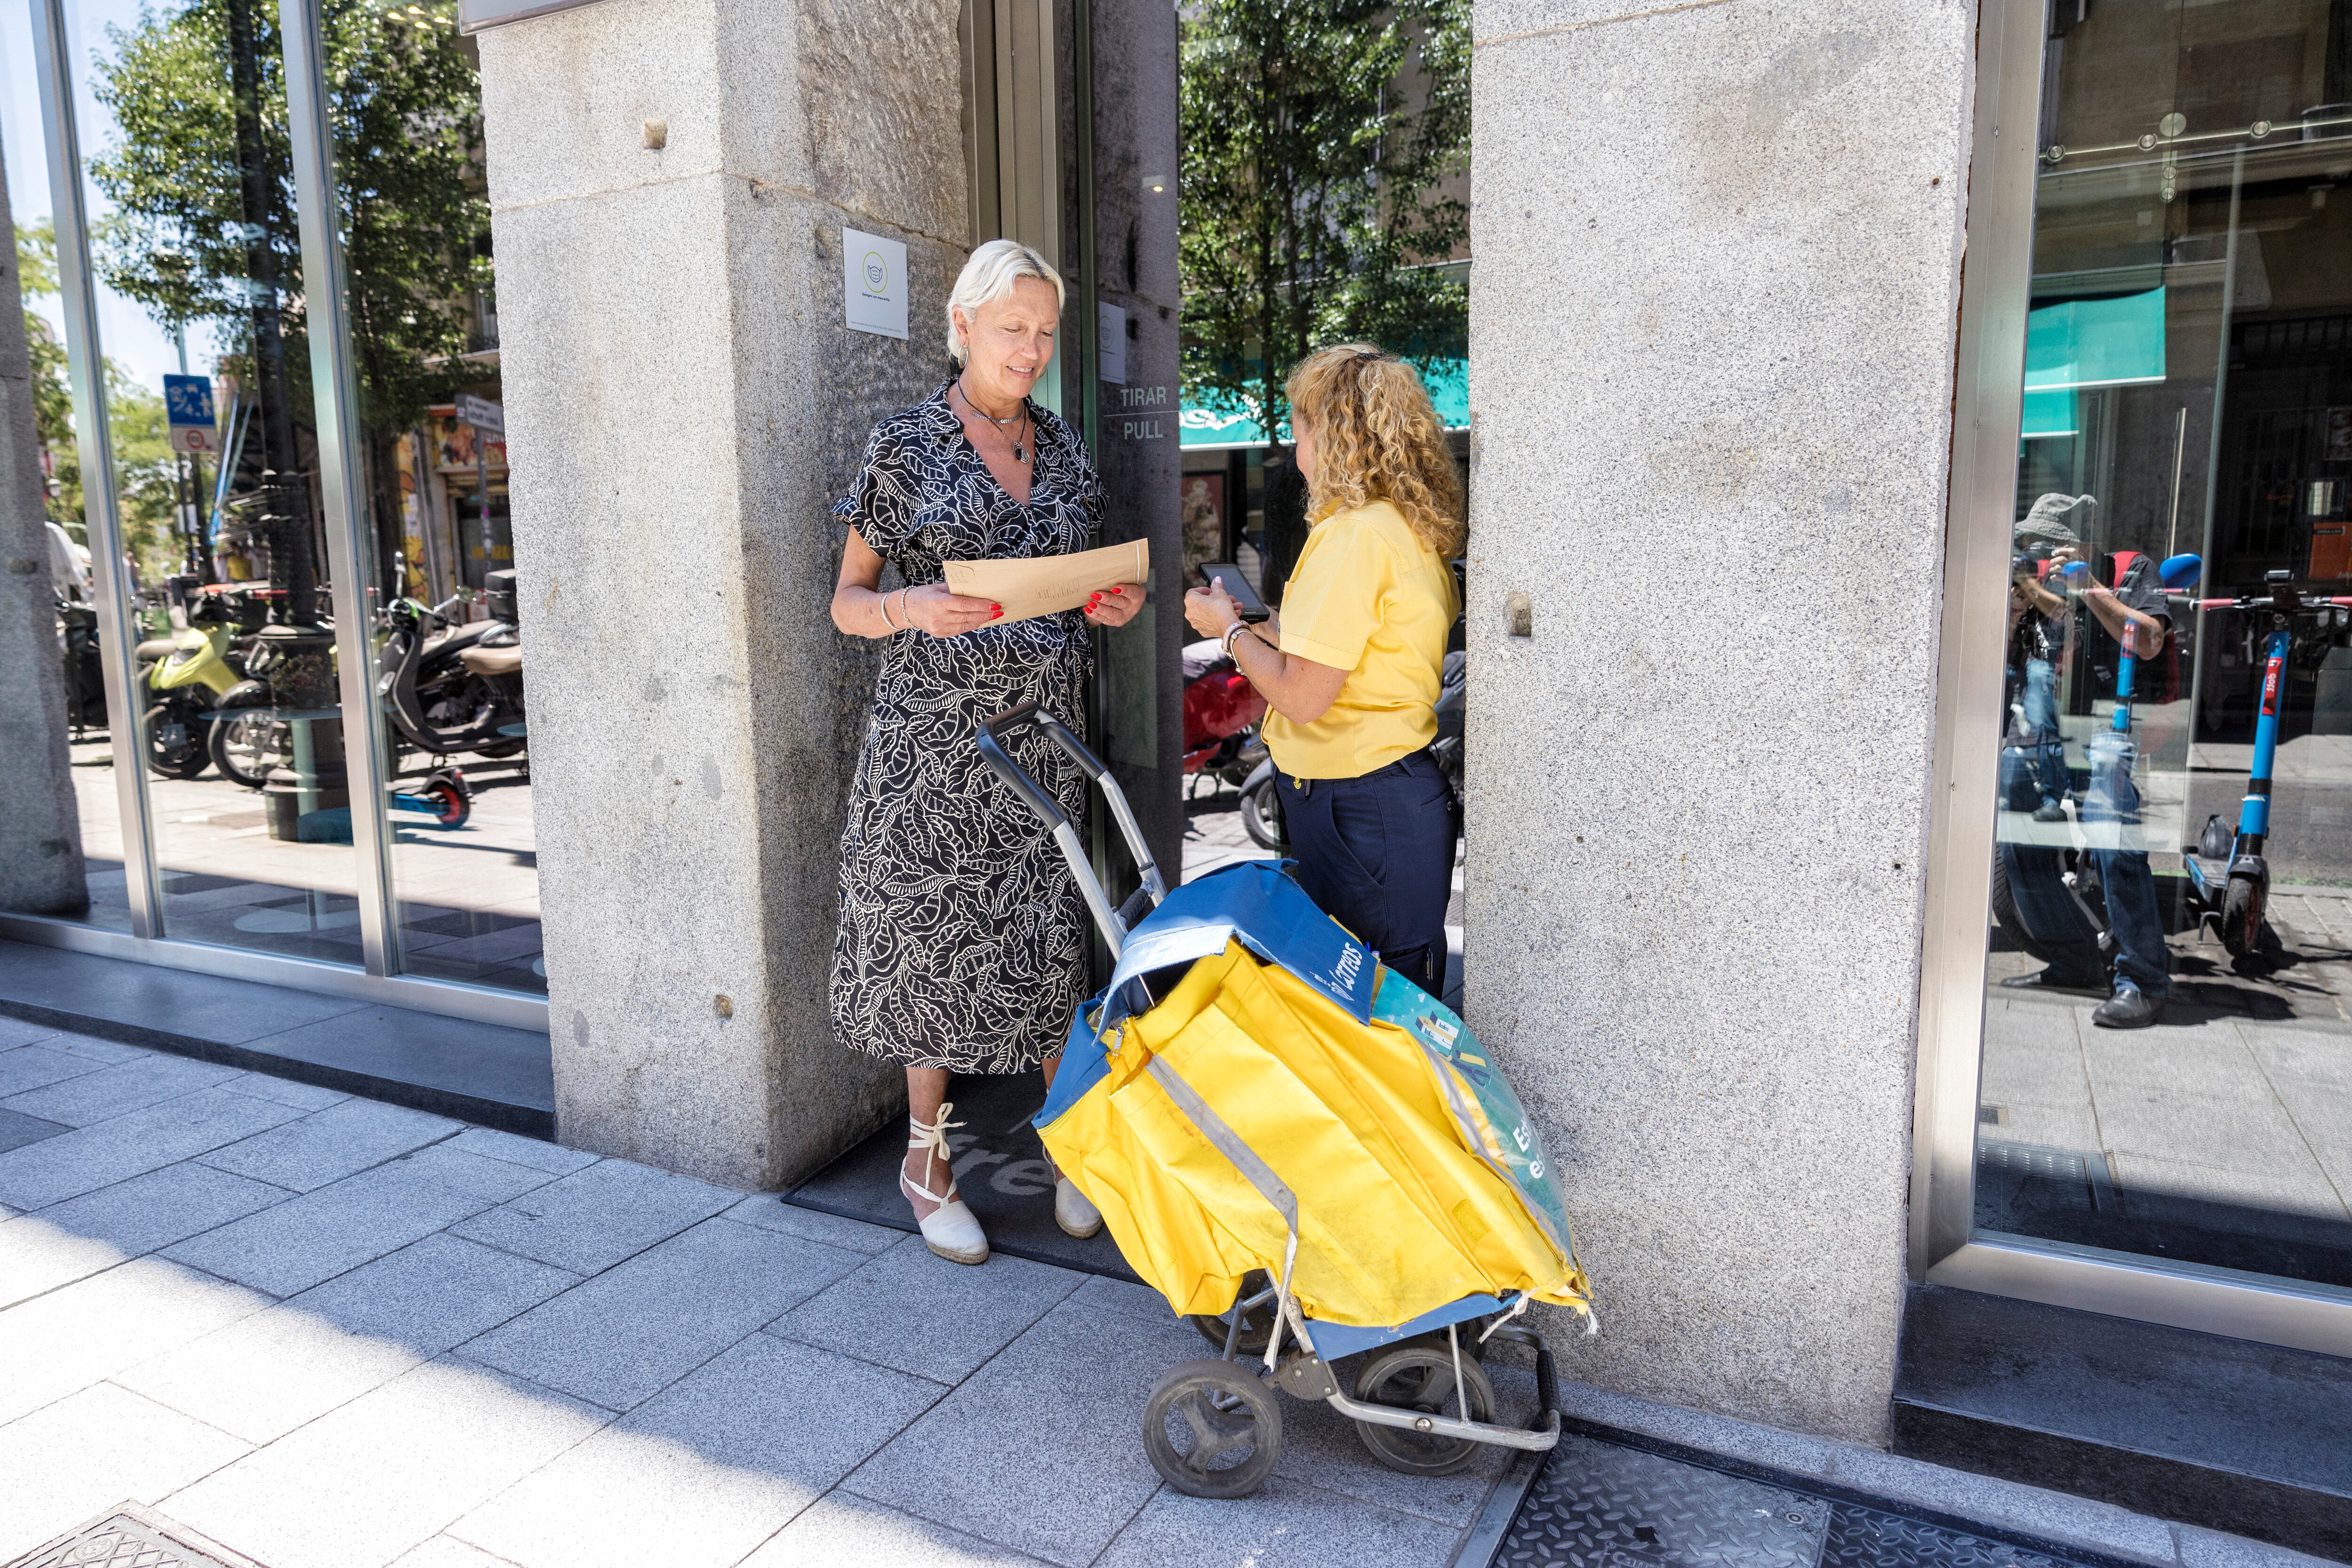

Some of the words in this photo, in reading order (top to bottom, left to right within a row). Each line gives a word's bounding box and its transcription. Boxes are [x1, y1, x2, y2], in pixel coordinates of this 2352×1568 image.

[1120, 386, 1167, 407] TIRAR
[1124, 420, 1163, 440] PULL
[1328, 942, 1363, 991] Correos
